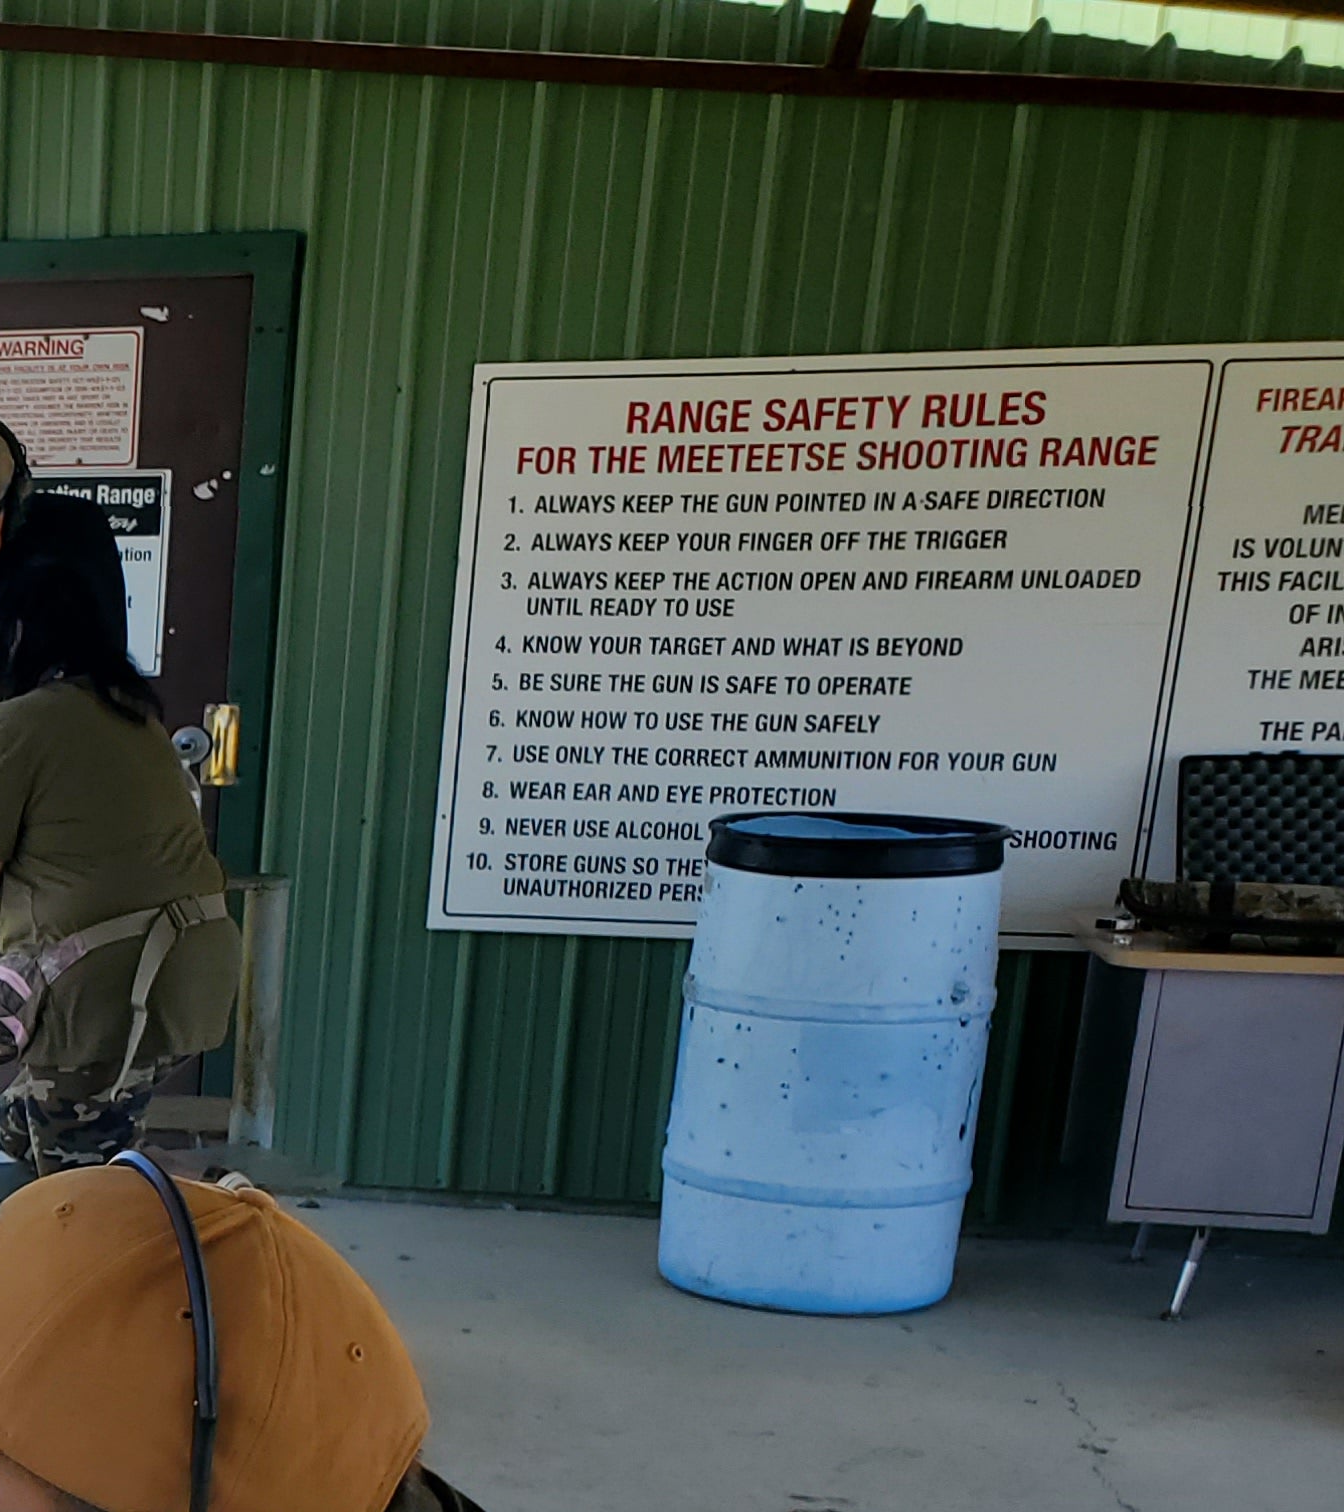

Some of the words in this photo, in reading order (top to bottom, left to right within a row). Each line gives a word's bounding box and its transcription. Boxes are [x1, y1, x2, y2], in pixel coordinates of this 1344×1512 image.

[626, 399, 753, 434] RANGE
[762, 395, 911, 433] SAFETY
[921, 390, 1047, 429] RULES
[517, 446, 577, 475] FOR
[588, 445, 647, 474] THE
[657, 441, 847, 474] MEETEETSE
[855, 437, 1028, 471] SHOOTING
[1039, 435, 1160, 467] RANGE
[96, 484, 156, 509] Range
[507, 495, 525, 514] 1.
[534, 494, 616, 514] ALWAYS
[622, 494, 674, 513] KEEP
[680, 494, 719, 513] THE
[725, 494, 769, 513] GUN
[775, 493, 867, 513] POINTED
[873, 492, 897, 512] IN
[924, 490, 980, 511] SAFE
[986, 487, 1106, 510] DIRECTION
[503, 533, 521, 552] 2.
[531, 532, 613, 552] ALWAYS
[618, 533, 670, 552] KEEP
[676, 532, 731, 552] YOUR
[737, 531, 813, 552] FINGER
[820, 531, 861, 551] OFF
[867, 531, 908, 551] THE
[914, 529, 1008, 551] TRIGGER
[1232, 537, 1256, 559] IS
[501, 571, 517, 590] 3.
[527, 571, 608, 591] ALWAYS
[614, 571, 666, 591] KEEP
[672, 571, 711, 591] THE
[715, 571, 793, 591] ACTION
[799, 571, 857, 591] OPEN
[861, 571, 908, 591] AND
[915, 569, 1014, 591] FIREARM
[1021, 569, 1141, 590] UNLOADED
[1217, 571, 1271, 592] THIS
[527, 597, 583, 617] UNTIL
[589, 597, 658, 617] READY
[663, 597, 689, 617] TO
[695, 598, 735, 618] USE
[1289, 603, 1321, 625] OF
[495, 635, 511, 654] 4.
[522, 635, 583, 654] KNOW
[589, 635, 642, 655] YOUR
[648, 636, 727, 656] TARGET
[731, 637, 776, 657] AND
[783, 637, 843, 657] WHAT
[849, 637, 869, 657] IS
[875, 637, 963, 657] BEYOND
[491, 673, 508, 691] 5.
[519, 673, 545, 691] BE
[549, 673, 602, 692] SURE
[608, 674, 646, 693] THE
[652, 674, 694, 694] GUN
[700, 675, 720, 694] IS
[725, 675, 778, 695] SAFE
[784, 676, 811, 695] TO
[817, 676, 913, 696] OPERATE
[1247, 669, 1293, 690] THE
[489, 709, 505, 727] 6.
[515, 709, 575, 729] KNOW
[581, 711, 628, 729] HOW
[633, 711, 659, 731] TO
[665, 711, 704, 731] USE
[710, 713, 749, 732] THE
[755, 713, 798, 733] GUN
[803, 714, 881, 734] SAFELY
[1259, 721, 1305, 741] THE
[486, 745, 502, 763] 7.
[513, 744, 550, 764] USE
[555, 745, 605, 765] ONLY
[611, 746, 649, 766] THE
[655, 747, 749, 768] CORRECT
[754, 749, 892, 771] AMMUNITION
[898, 751, 940, 771] FOR
[947, 752, 1005, 772] YOUR
[1012, 752, 1057, 772] GUN
[482, 781, 499, 799] 8.
[509, 781, 567, 801] WEAR
[573, 783, 611, 802] EAR
[617, 783, 660, 803] AND
[666, 785, 704, 804] EYE
[709, 786, 837, 807] PROTECTION
[479, 817, 495, 835] 9.
[505, 817, 567, 837] NEVER
[573, 819, 610, 839] USE
[615, 820, 704, 841] ALCOHOL
[1009, 829, 1118, 851] SHOOTING
[466, 852, 492, 871] 10.
[504, 853, 568, 873] STORE
[573, 855, 627, 875] GUNS
[632, 857, 659, 876] SO
[666, 858, 708, 877] THE
[503, 877, 653, 901] UNAUTHORIZED
